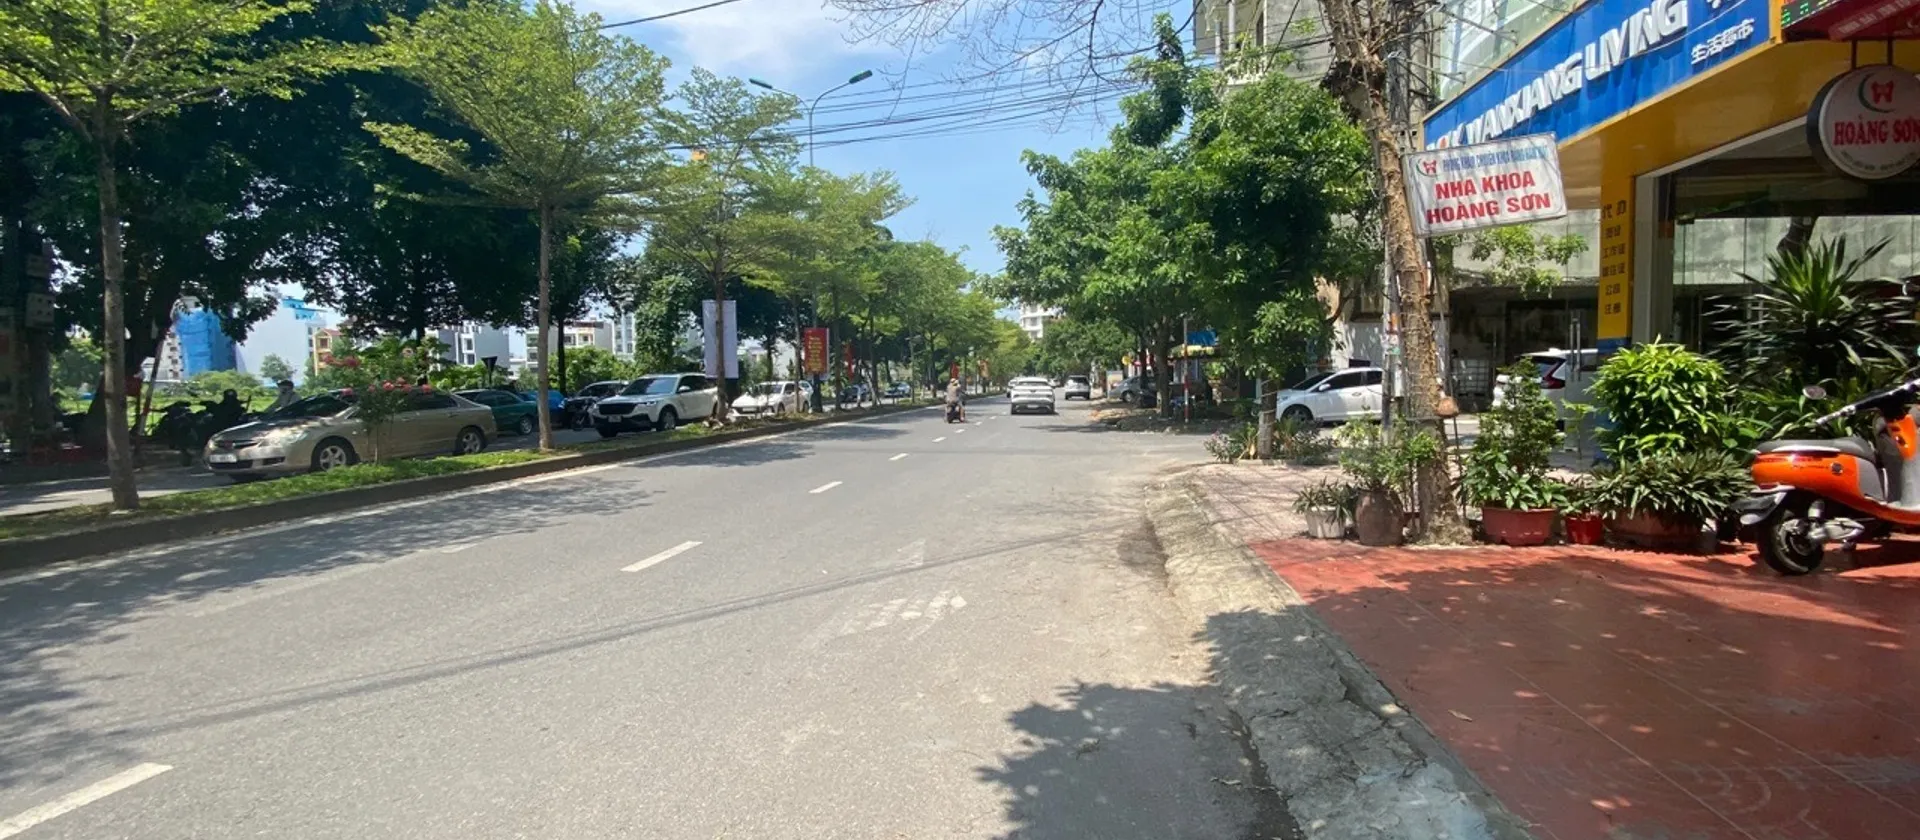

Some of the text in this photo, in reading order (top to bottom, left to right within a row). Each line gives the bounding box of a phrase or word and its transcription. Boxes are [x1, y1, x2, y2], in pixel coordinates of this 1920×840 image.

[1691, 17, 1756, 64] 生活超市
[1465, 0, 1688, 144] WANXIANG LIVING
[1833, 114, 1888, 146] HOÀNG
[1435, 171, 1535, 200] NHA KHOA
[1426, 193, 1551, 224] HOÀNG SƠN
